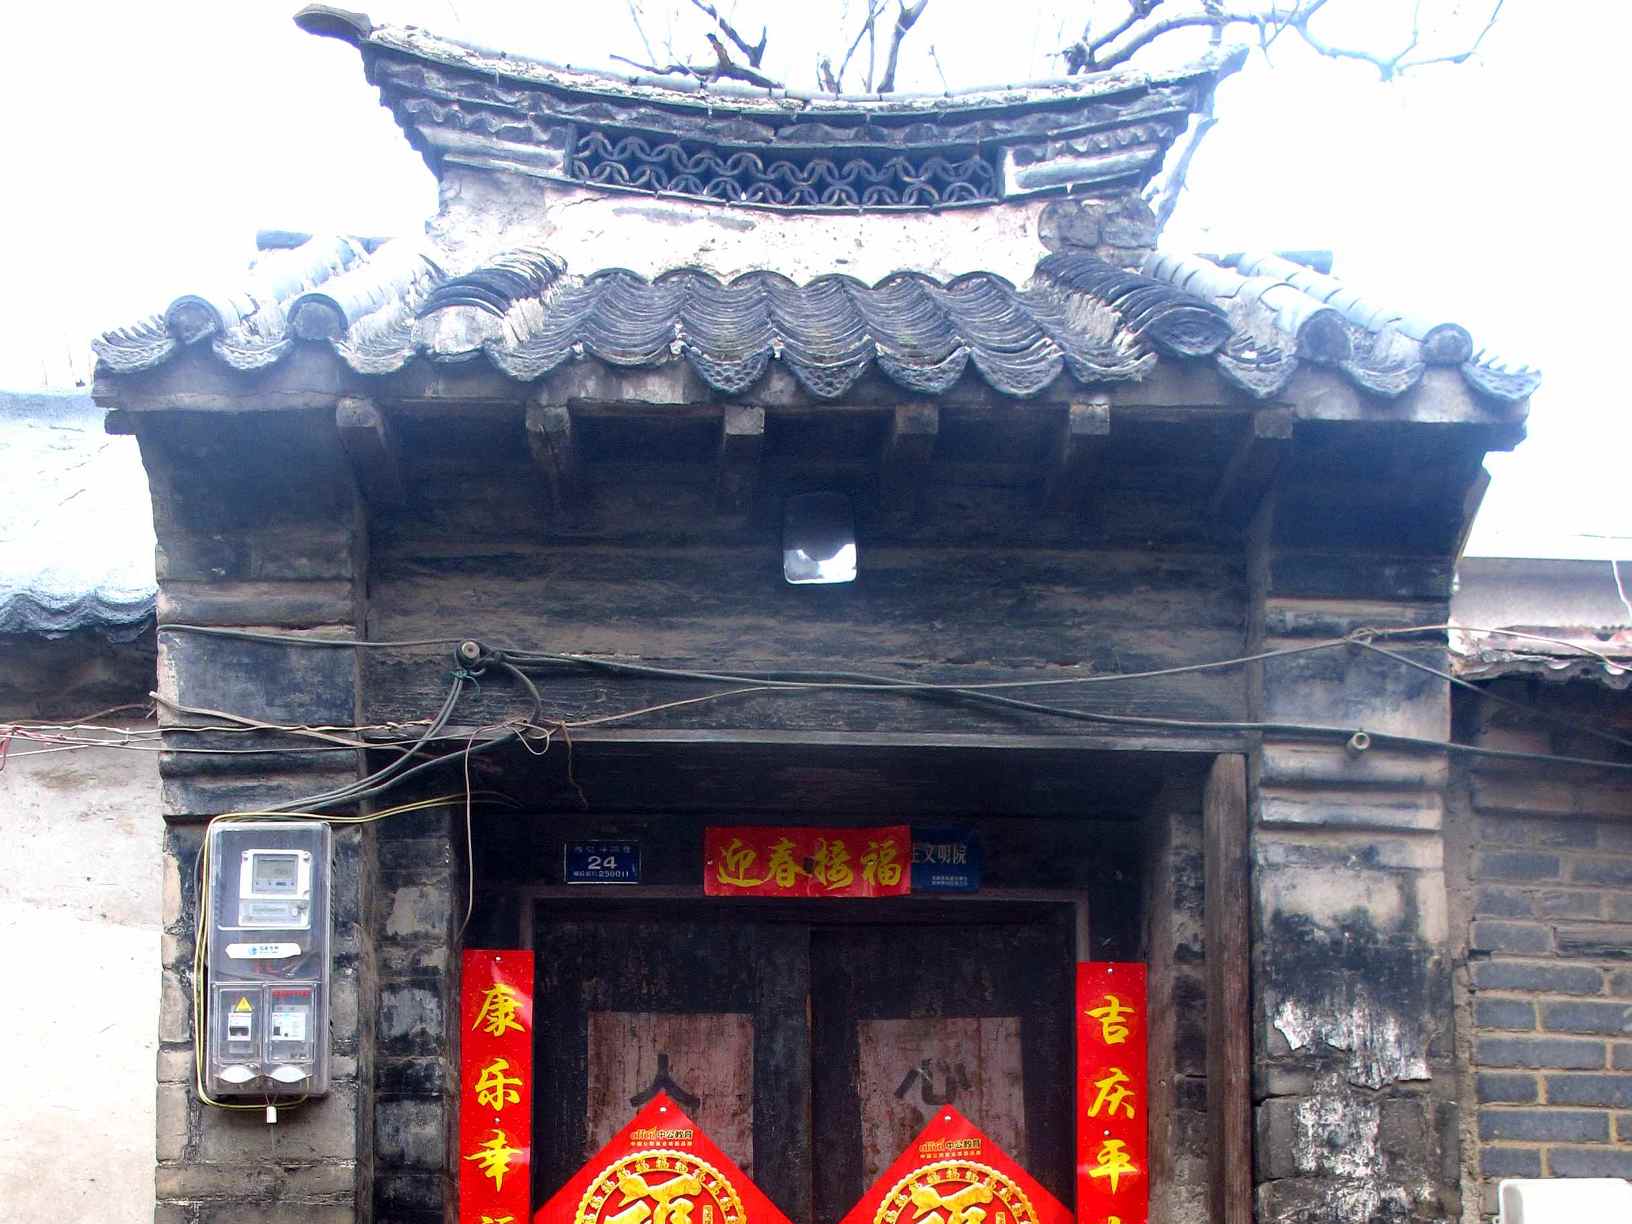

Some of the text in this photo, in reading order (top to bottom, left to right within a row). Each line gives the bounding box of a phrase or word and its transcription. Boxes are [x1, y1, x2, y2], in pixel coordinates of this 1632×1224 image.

[588, 855, 617, 870] 24
[718, 837, 902, 889] 迎春接福
